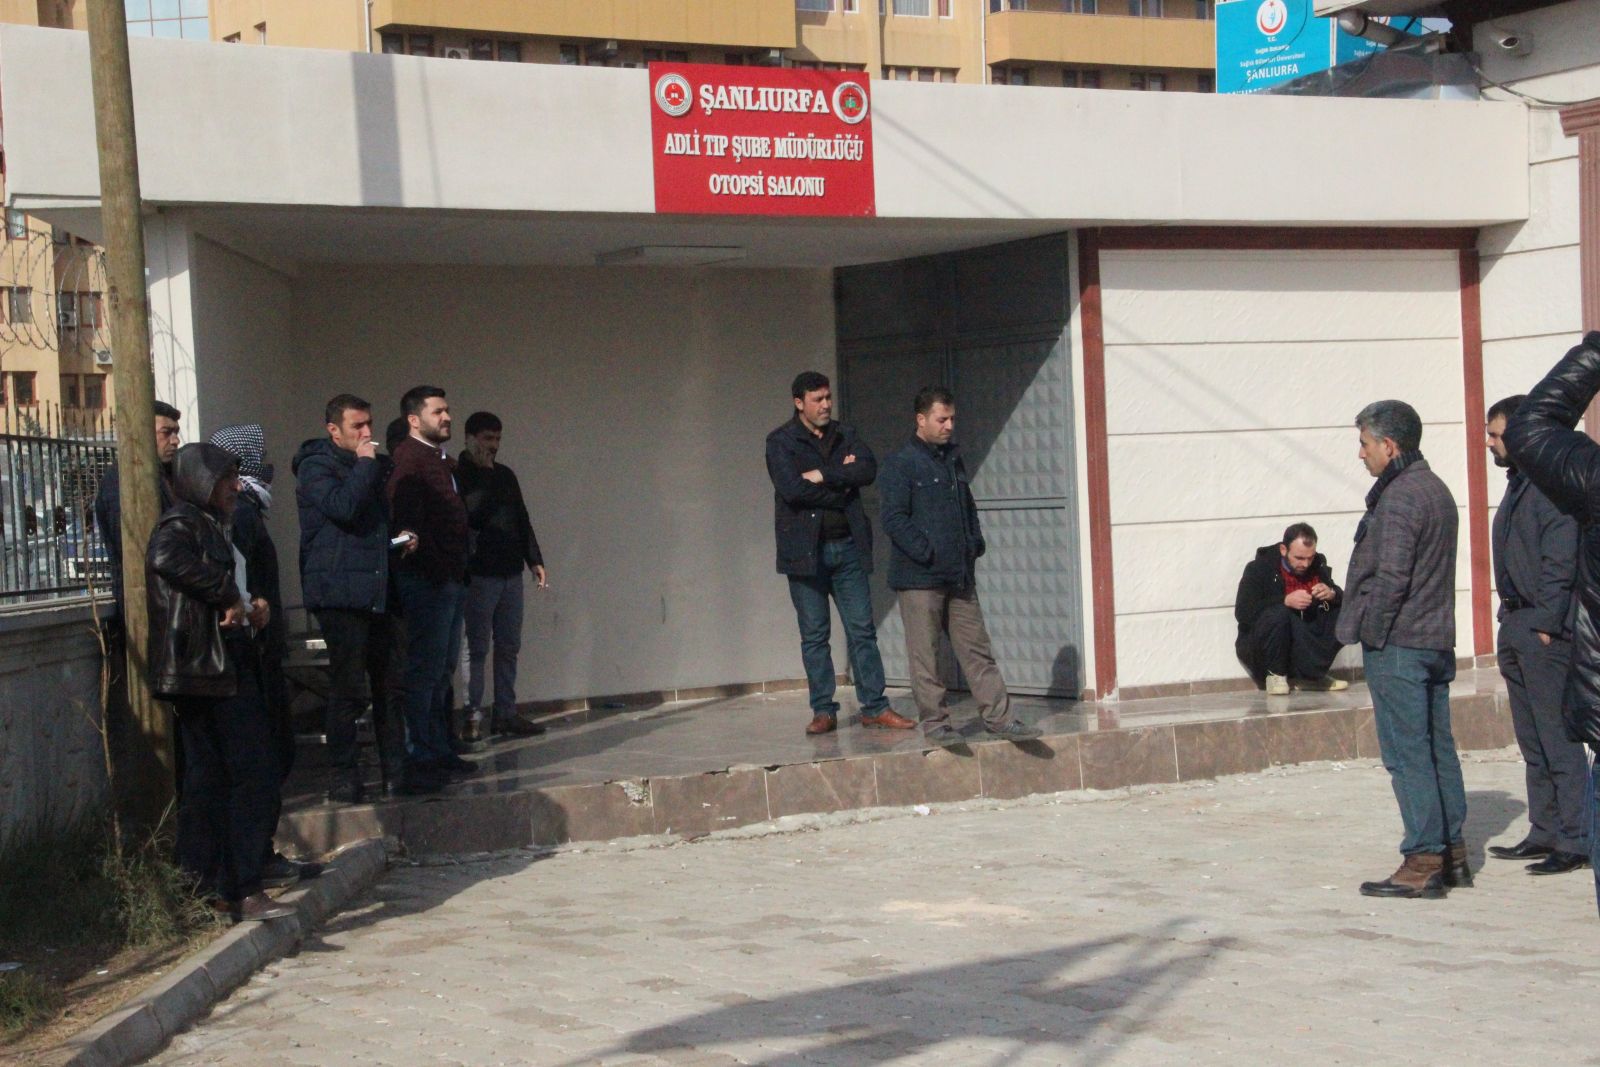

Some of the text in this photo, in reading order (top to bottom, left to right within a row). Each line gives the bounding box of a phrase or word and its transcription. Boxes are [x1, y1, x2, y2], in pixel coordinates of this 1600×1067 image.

[1246, 63, 1299, 83] ŞANLIURFA
[699, 83, 830, 115] ŞANLIURFA
[664, 128, 863, 163] ADLİ TIP ŞUBE MÜDÜRLÜĞÜ
[709, 170, 825, 197] OTOPSİ SALONU
